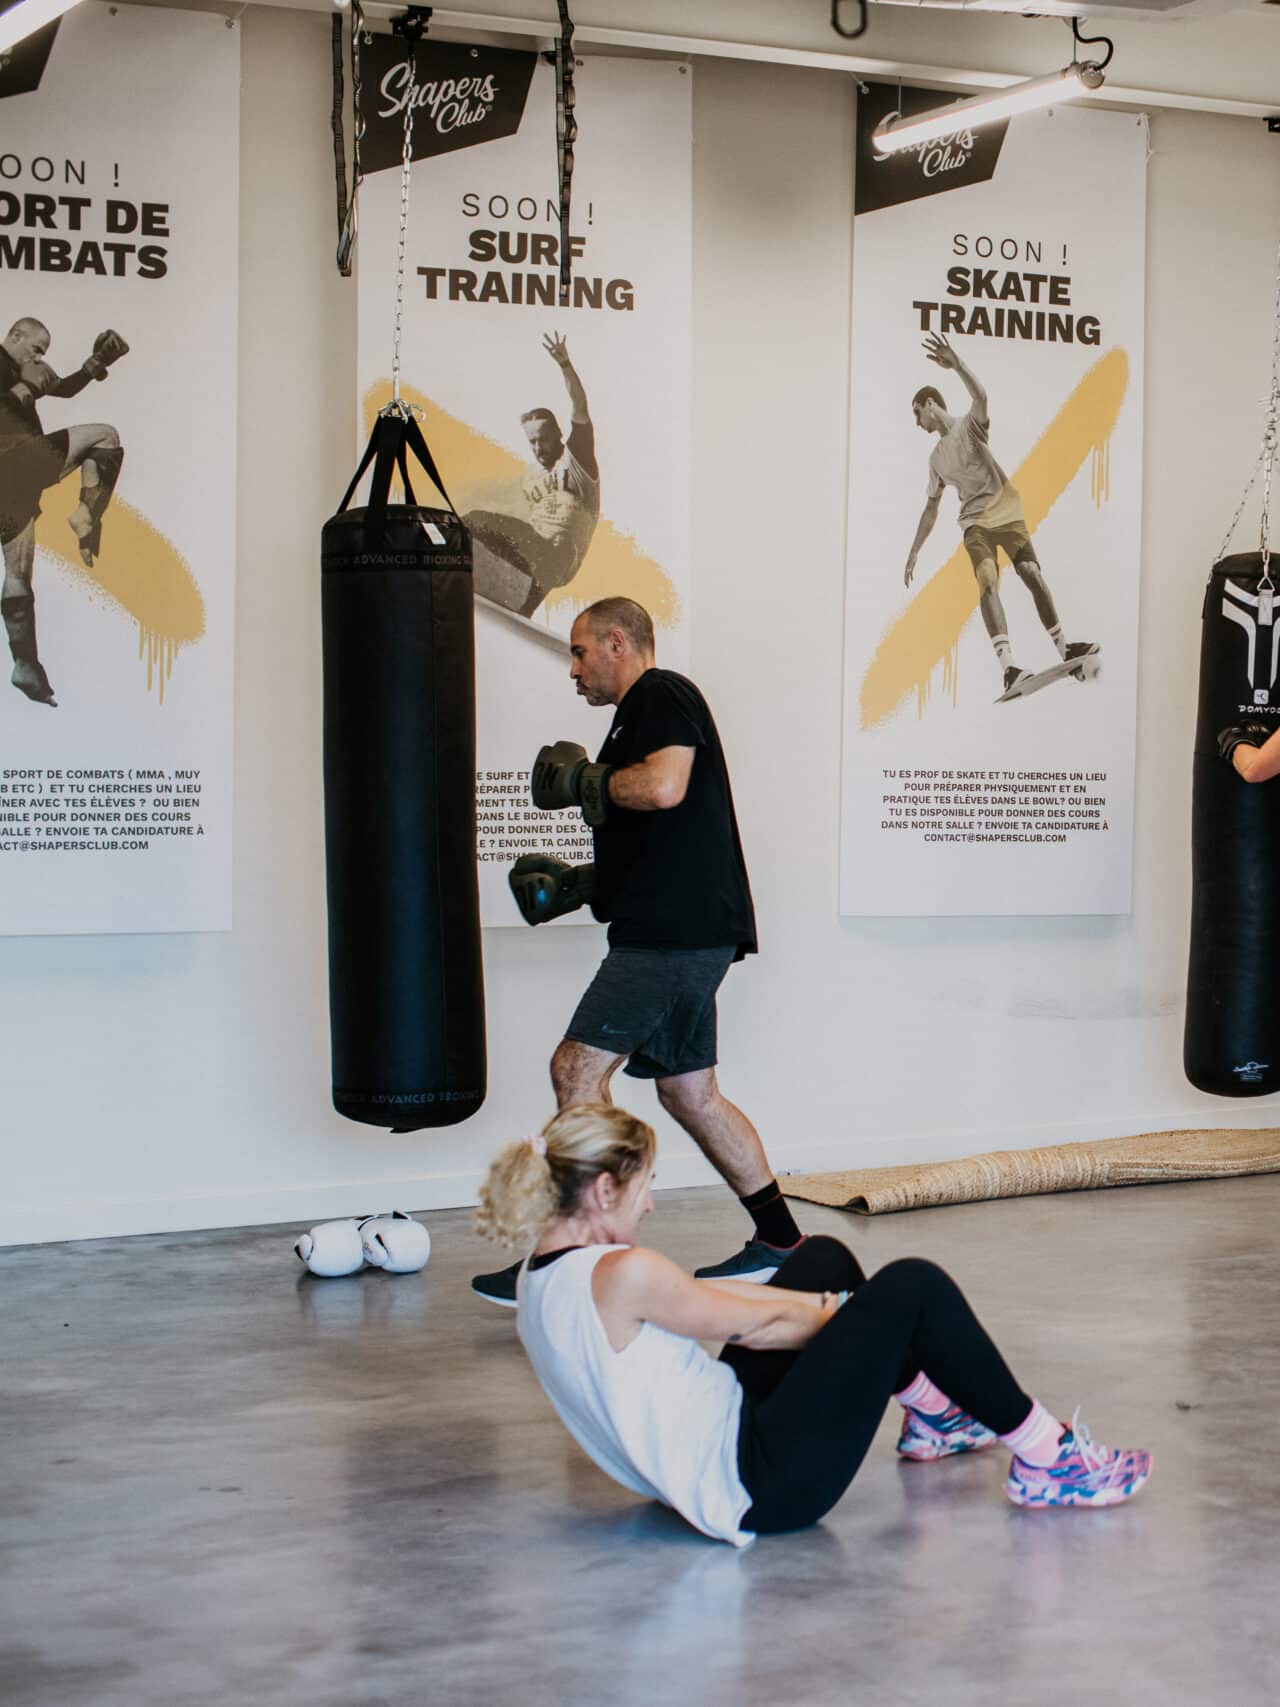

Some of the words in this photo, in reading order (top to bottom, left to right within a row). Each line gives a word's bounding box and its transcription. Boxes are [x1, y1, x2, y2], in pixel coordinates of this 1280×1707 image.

[378, 62, 499, 118] Shapers
[436, 99, 485, 133] Club
[923, 146, 965, 177] Club
[0, 154, 85, 184] OON
[0, 191, 91, 230] ORT
[106, 200, 169, 237] DE
[953, 234, 1041, 262] SOON
[0, 235, 168, 279] MBATS
[946, 266, 1071, 306] SKATE
[913, 301, 1100, 345] TRAINING
[3, 770, 42, 779] SPORT
[47, 770, 62, 779] DE
[67, 770, 124, 779] COMBATS
[136, 770, 164, 779] MMA
[175, 770, 200, 779] MUY
[486, 772, 514, 780] SURF
[517, 772, 530, 780] ET
[883, 770, 896, 778] TU
[899, 770, 911, 778] ES
[914, 771, 939, 779] PROF
[942, 771, 954, 779] DE
[956, 772, 986, 780] SKATE
[988, 772, 1000, 780] ET
[1002, 772, 1015, 780] TU
[1018, 772, 1066, 780] CHERCHES
[1070, 773, 1083, 781] UN
[1086, 773, 1107, 781] LIEU
[12, 784, 34, 793] ETC
[50, 784, 64, 793] ET
[69, 784, 84, 793] TU
[89, 784, 152, 793] CHERCHES
[156, 784, 172, 793] UN
[177, 784, 201, 793] LIEU
[476, 784, 520, 793] ÉPARER
[904, 783, 930, 791] POUR
[934, 782, 981, 792] PRÉPARER
[984, 784, 1056, 793] PHYSIQUEMENT
[1059, 785, 1070, 793] ET
[1074, 785, 1086, 793] EN
[30, 799, 60, 807] AVEC
[64, 799, 86, 807] TES
[91, 796, 135, 807] ÉLÈVES
[153, 799, 169, 807] OU
[173, 799, 200, 807] BIEN
[883, 796, 931, 805] PRATIQUE
[934, 796, 951, 804] TES
[954, 794, 989, 805] ÉLÈVES
[991, 797, 1016, 805] DANS
[1019, 797, 1030, 805] LE
[1068, 797, 1081, 805] OU
[1084, 798, 1105, 806] BIEN
[34, 813, 66, 822] POUR
[71, 813, 120, 821] DONNER
[125, 813, 147, 821] DES
[151, 812, 191, 821] COURS
[508, 812, 520, 820] LE
[524, 812, 555, 820] BOWL
[889, 808, 902, 816] TU
[905, 809, 917, 817] ES
[920, 809, 975, 817] DISPONIBLE
[978, 809, 1003, 817] POUR
[1006, 809, 1045, 817] DONNER
[1068, 810, 1100, 818] COURS
[0, 827, 31, 836] ALLE
[46, 827, 90, 836] ENVOIE
[94, 827, 108, 836] TA
[112, 826, 193, 835] CANDIDATURE
[197, 824, 204, 835] À
[556, 825, 576, 833] DES
[881, 821, 908, 829] DANS
[911, 821, 943, 829] NOTRE
[985, 822, 1016, 830] ENVOIE
[1021, 822, 1032, 830] TA
[1035, 822, 1100, 830] CANDIDATURE
[1103, 820, 1109, 830] À
[499, 839, 537, 847] ENVOIE
[924, 833, 1066, 843] CONTACT@SHAPERSCLUB.COM
